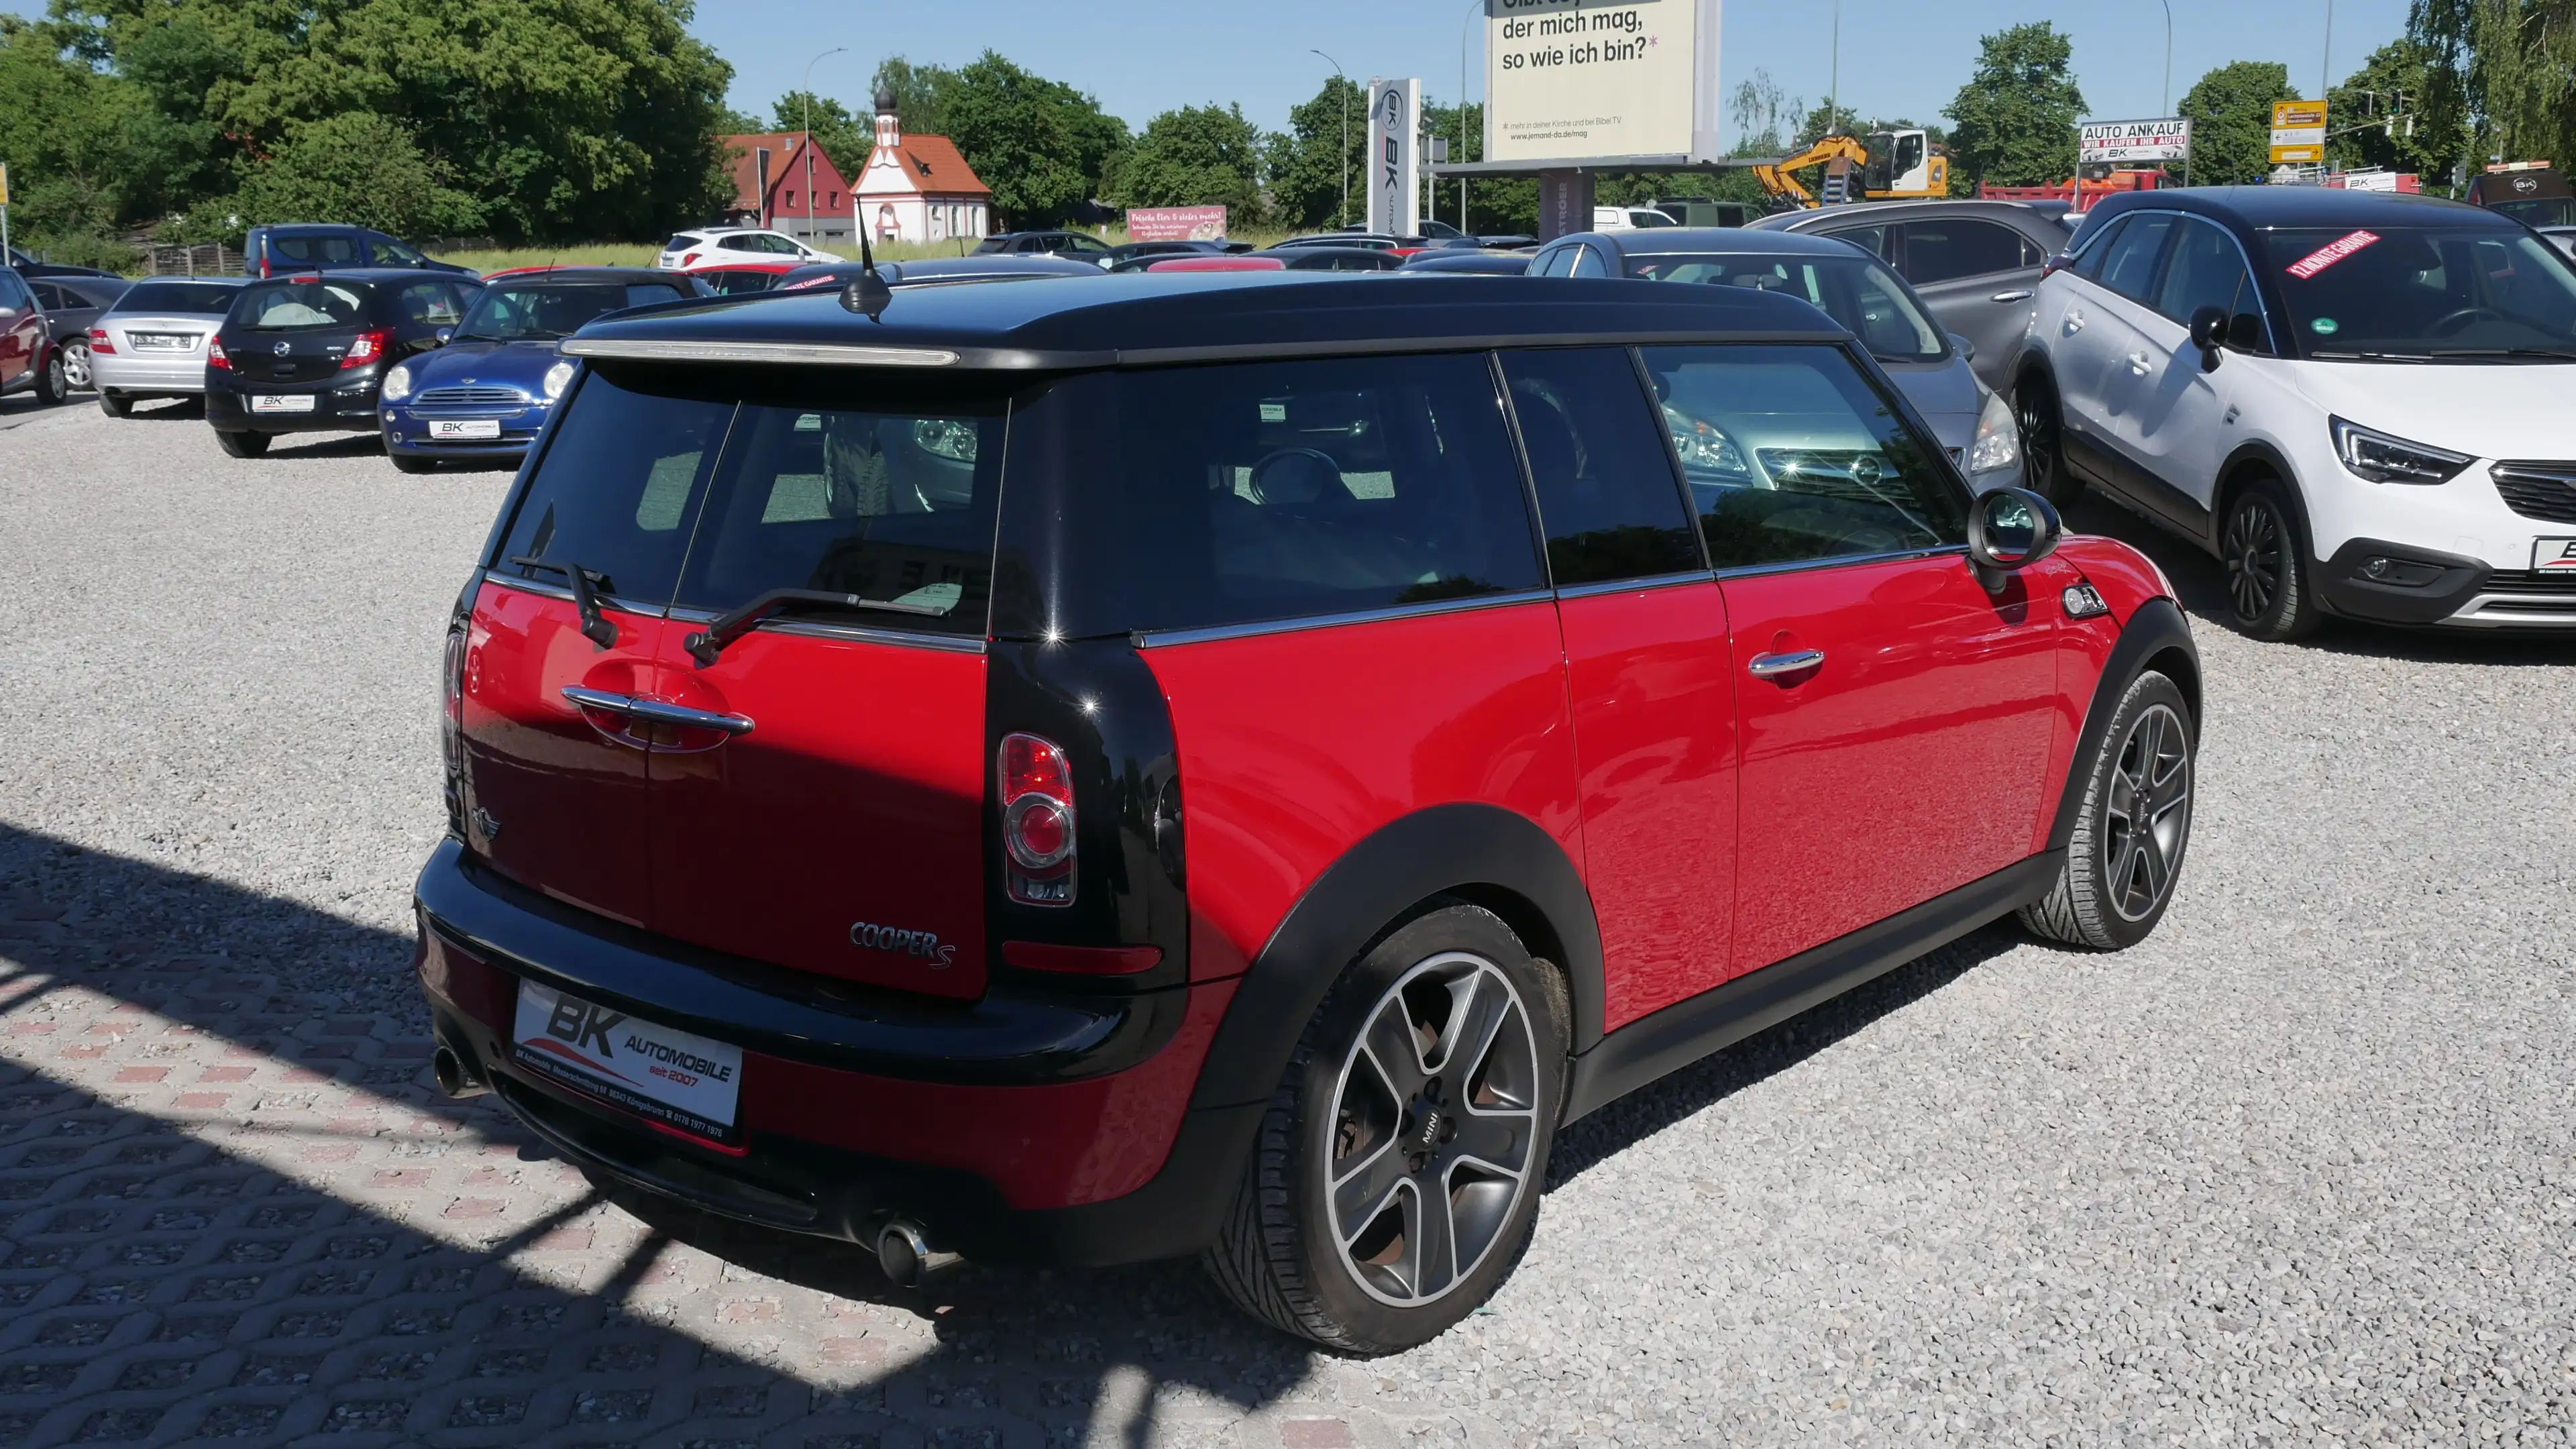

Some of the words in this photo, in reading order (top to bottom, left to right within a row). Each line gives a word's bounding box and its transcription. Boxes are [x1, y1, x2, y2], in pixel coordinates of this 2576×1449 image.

[1503, 18, 1534, 39] der
[1540, 11, 1586, 36] mich
[1593, 11, 1642, 33] mag,
[1503, 53, 1524, 70] so
[1530, 46, 1564, 67] wie
[1570, 42, 1598, 64] ich
[1388, 94, 1397, 125] BK
[1552, 119, 1572, 127] Kirche
[1572, 119, 1584, 127] und
[1596, 117, 1611, 125] Bibel
[1613, 116, 1622, 124] TV
[2085, 126, 2121, 139] AUTO
[2128, 123, 2184, 137] ANKAUF
[1510, 130, 1588, 141] www.jemand-da.de/mag
[2084, 140, 2100, 148] WIR
[2103, 138, 2137, 147] KAUFEN
[2158, 136, 2183, 144] AUTO
[1385, 136, 1398, 191] BK
[2108, 149, 2128, 158] BK
[2350, 178, 2368, 187] BK
[1199, 211, 1221, 220] mehr!
[2330, 231, 2379, 254] GARANTIE
[2290, 265, 2312, 277] 12
[2300, 248, 2343, 272] MONATE
[264, 396, 284, 405] BK
[442, 423, 464, 432] BK
[849, 921, 937, 959] COOPER
[928, 945, 956, 970] S
[546, 993, 628, 1059] BK
[625, 1035, 733, 1083] AUTOMOBILE
[649, 1065, 667, 1079] seit
[668, 1072, 699, 1087] 2007
[516, 1049, 525, 1060] BK
[524, 1053, 551, 1071] Automobile
[627, 1094, 665, 1117] Königsbrunn
[690, 1118, 706, 1131] 1977
[707, 1124, 723, 1138] 1976
[1422, 1112, 1438, 1143] MINI
